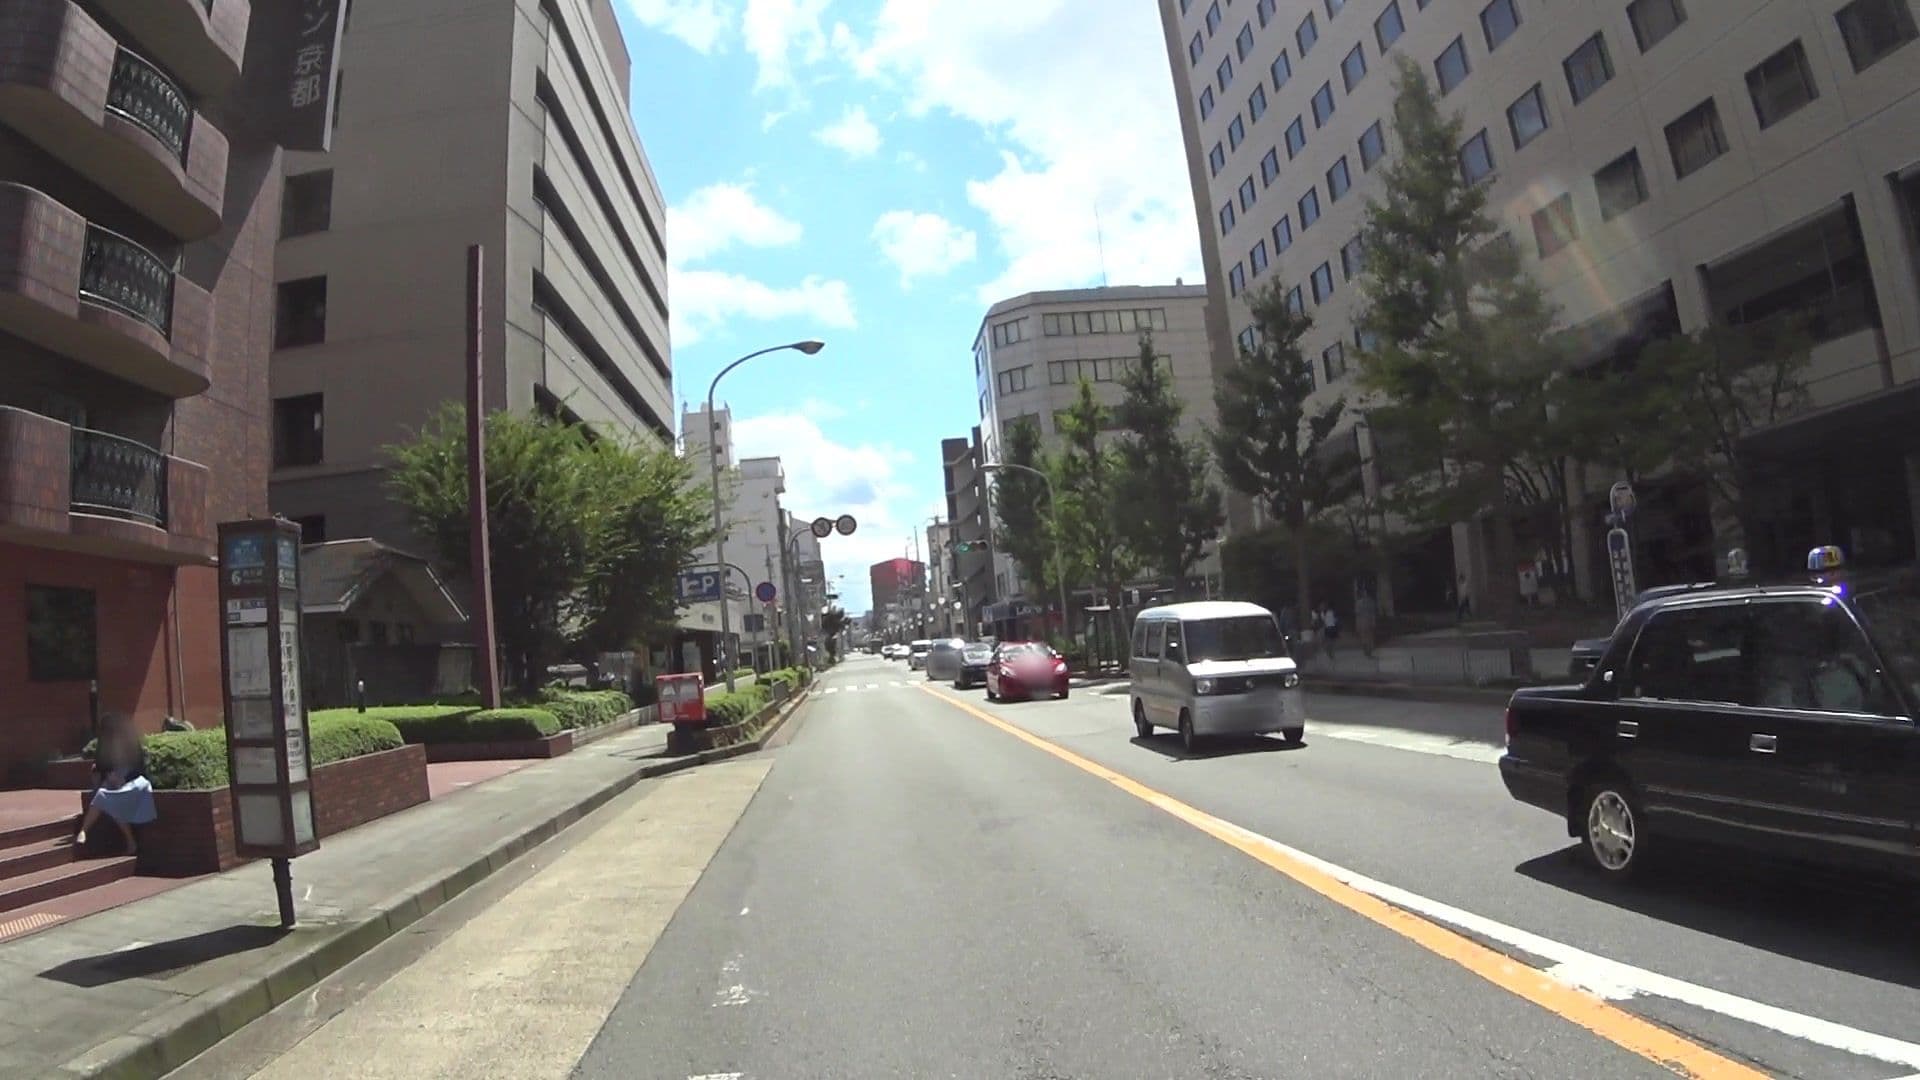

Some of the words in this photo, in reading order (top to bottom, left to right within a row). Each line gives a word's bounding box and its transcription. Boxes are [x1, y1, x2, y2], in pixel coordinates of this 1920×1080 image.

[291, 0, 330, 108] ン京都
[231, 569, 242, 586] 6
